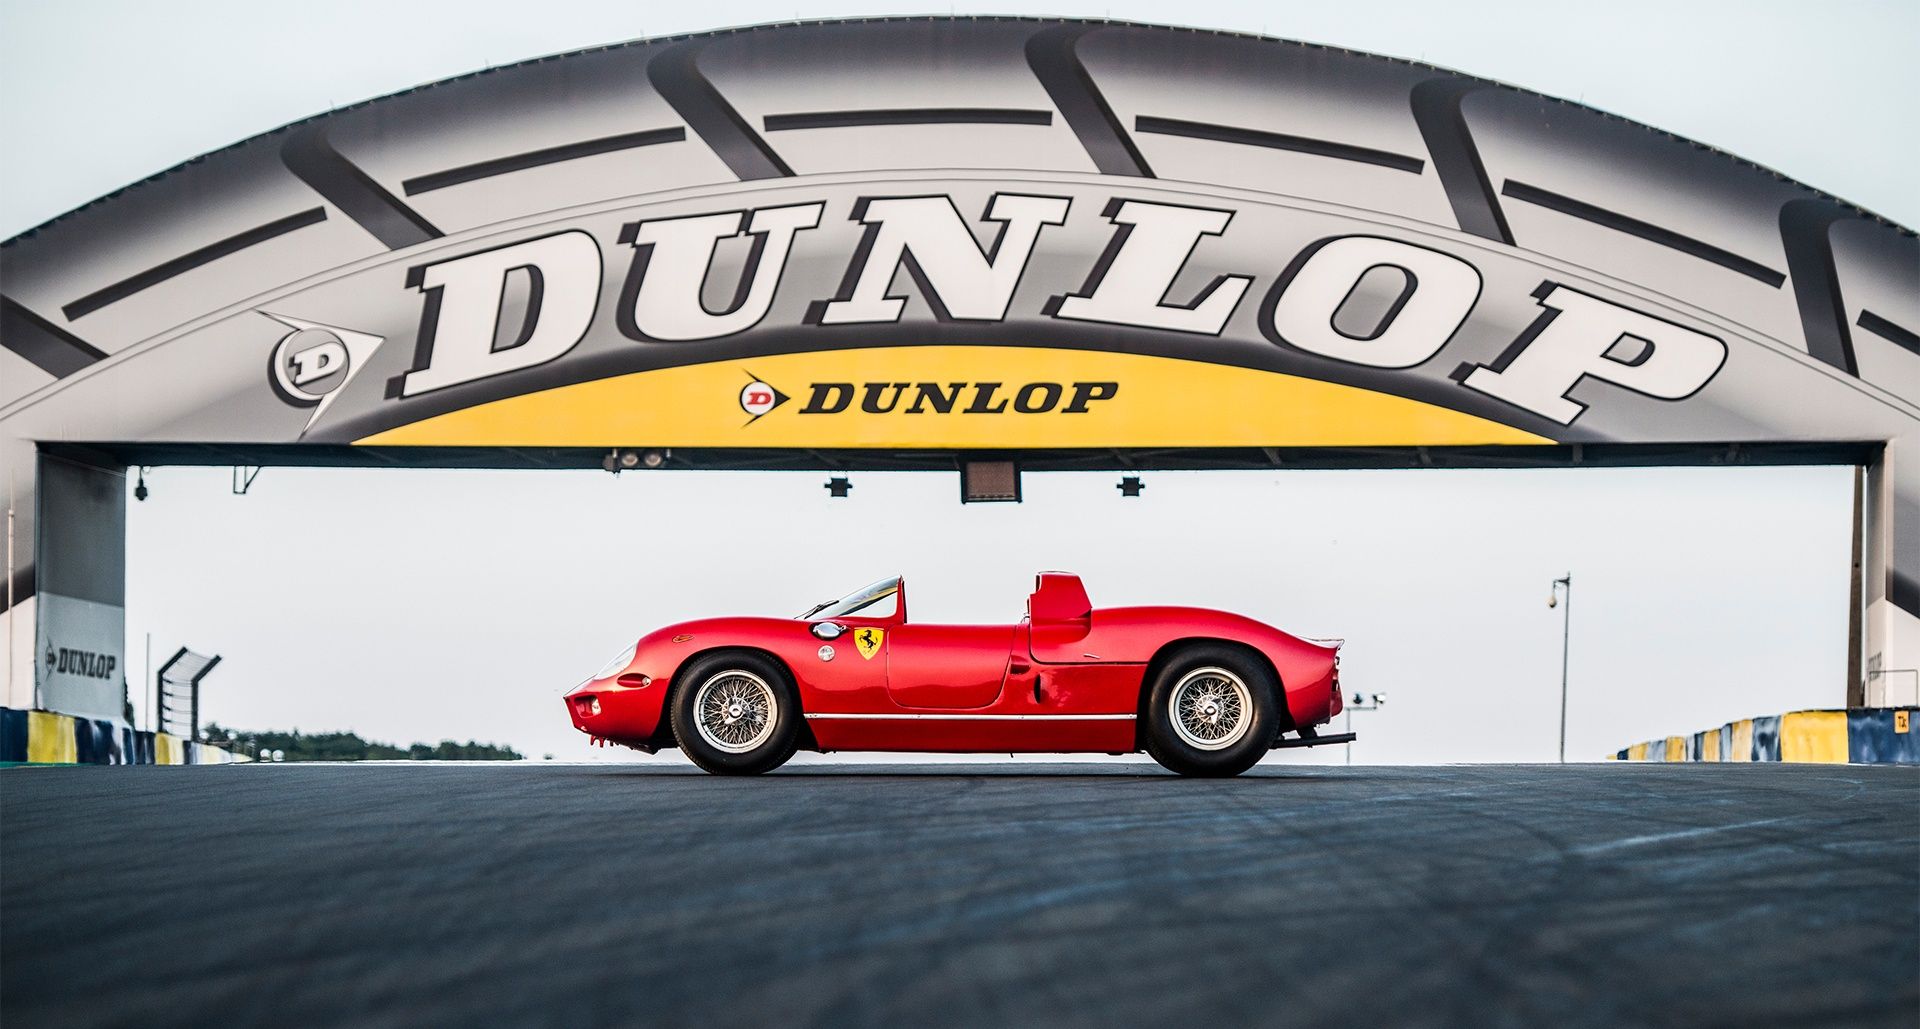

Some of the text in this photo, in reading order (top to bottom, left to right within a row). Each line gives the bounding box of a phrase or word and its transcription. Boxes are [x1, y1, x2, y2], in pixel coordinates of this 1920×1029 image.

[288, 193, 1729, 427] D DUNLOP
[746, 382, 1119, 414] D DUNLOP
[57, 647, 115, 680] DUNLOP
